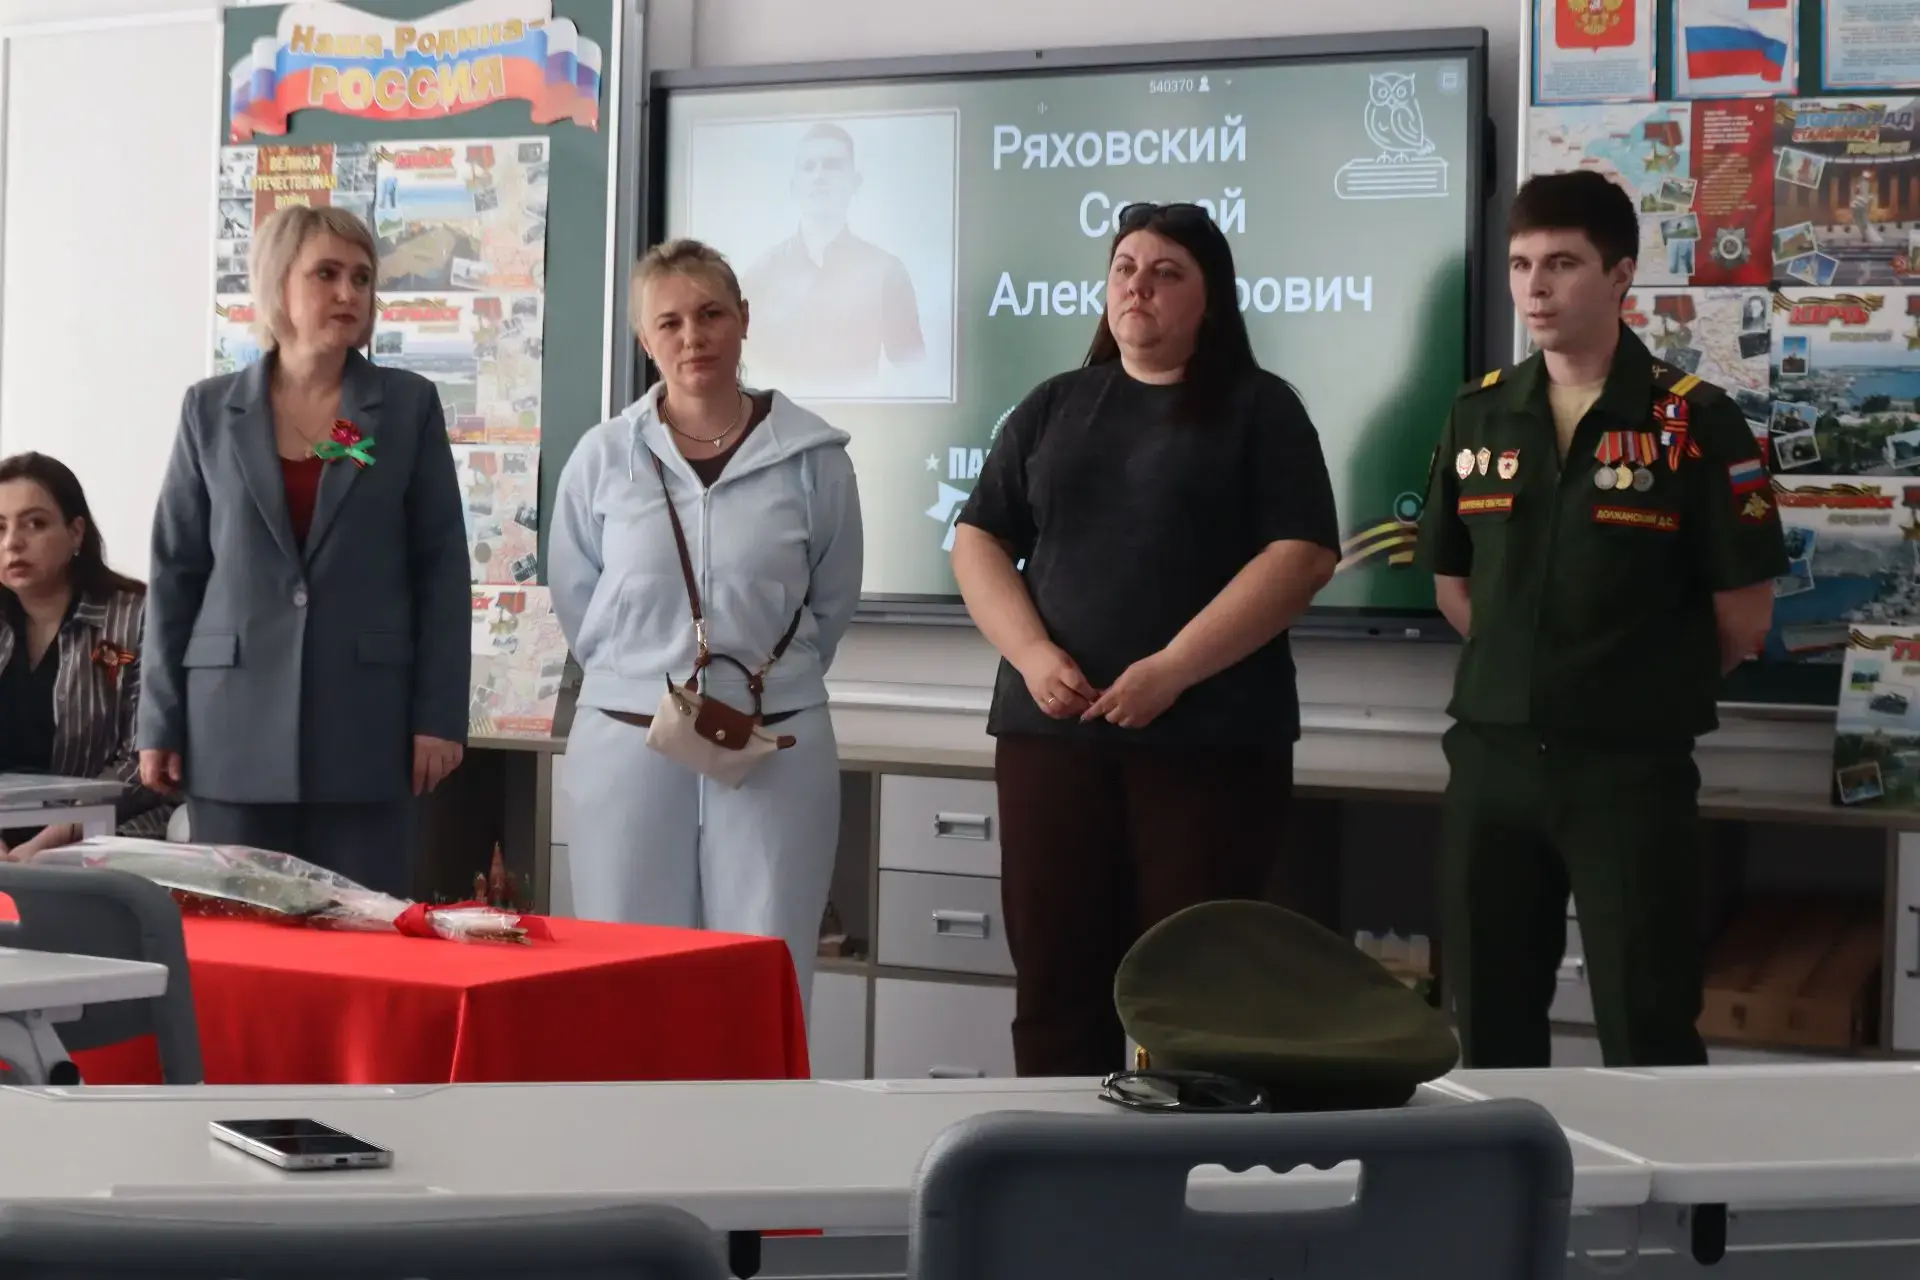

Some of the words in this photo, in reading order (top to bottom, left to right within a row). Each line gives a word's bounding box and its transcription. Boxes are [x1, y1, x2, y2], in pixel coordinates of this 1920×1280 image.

[290, 24, 384, 58] Наша
[308, 55, 505, 111] РОССИЯ
[993, 113, 1246, 170] Ряховский
[988, 271, 1373, 317] Алекович
